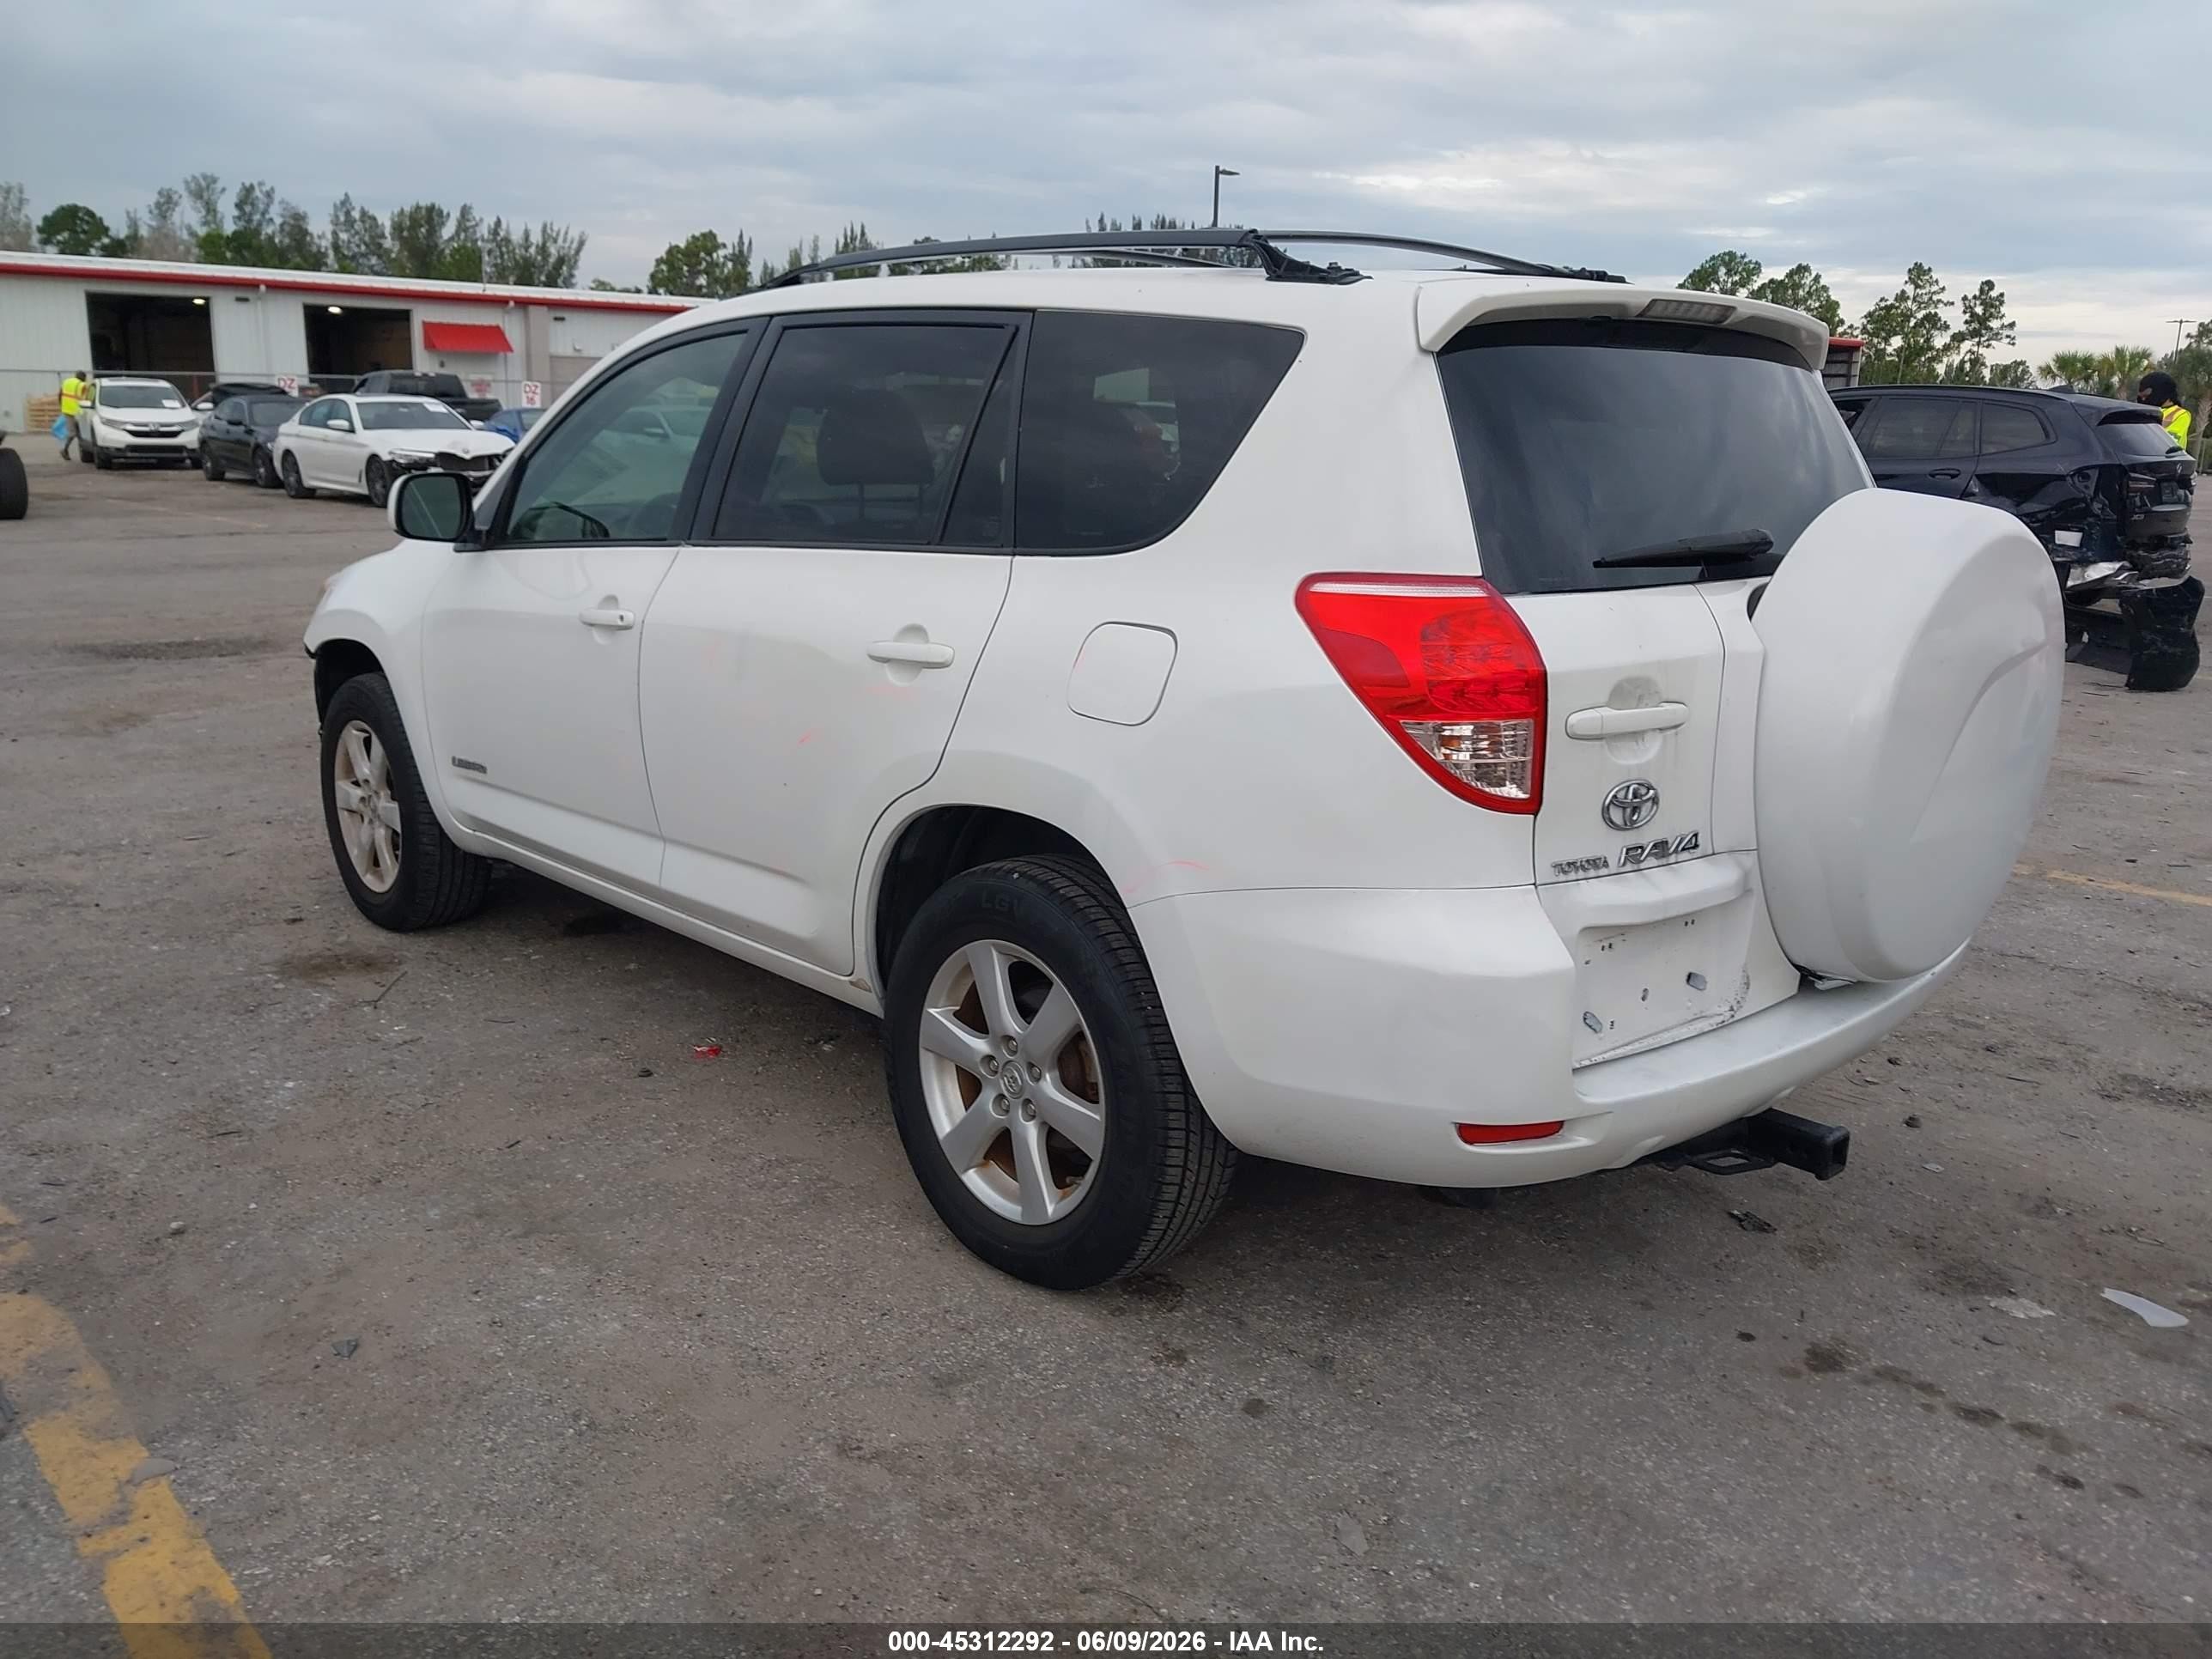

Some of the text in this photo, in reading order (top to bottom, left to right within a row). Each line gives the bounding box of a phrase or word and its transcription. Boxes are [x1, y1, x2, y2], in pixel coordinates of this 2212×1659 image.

[524, 383, 538, 395] DZ
[1551, 831, 1699, 877] TOYOTA RAV4
